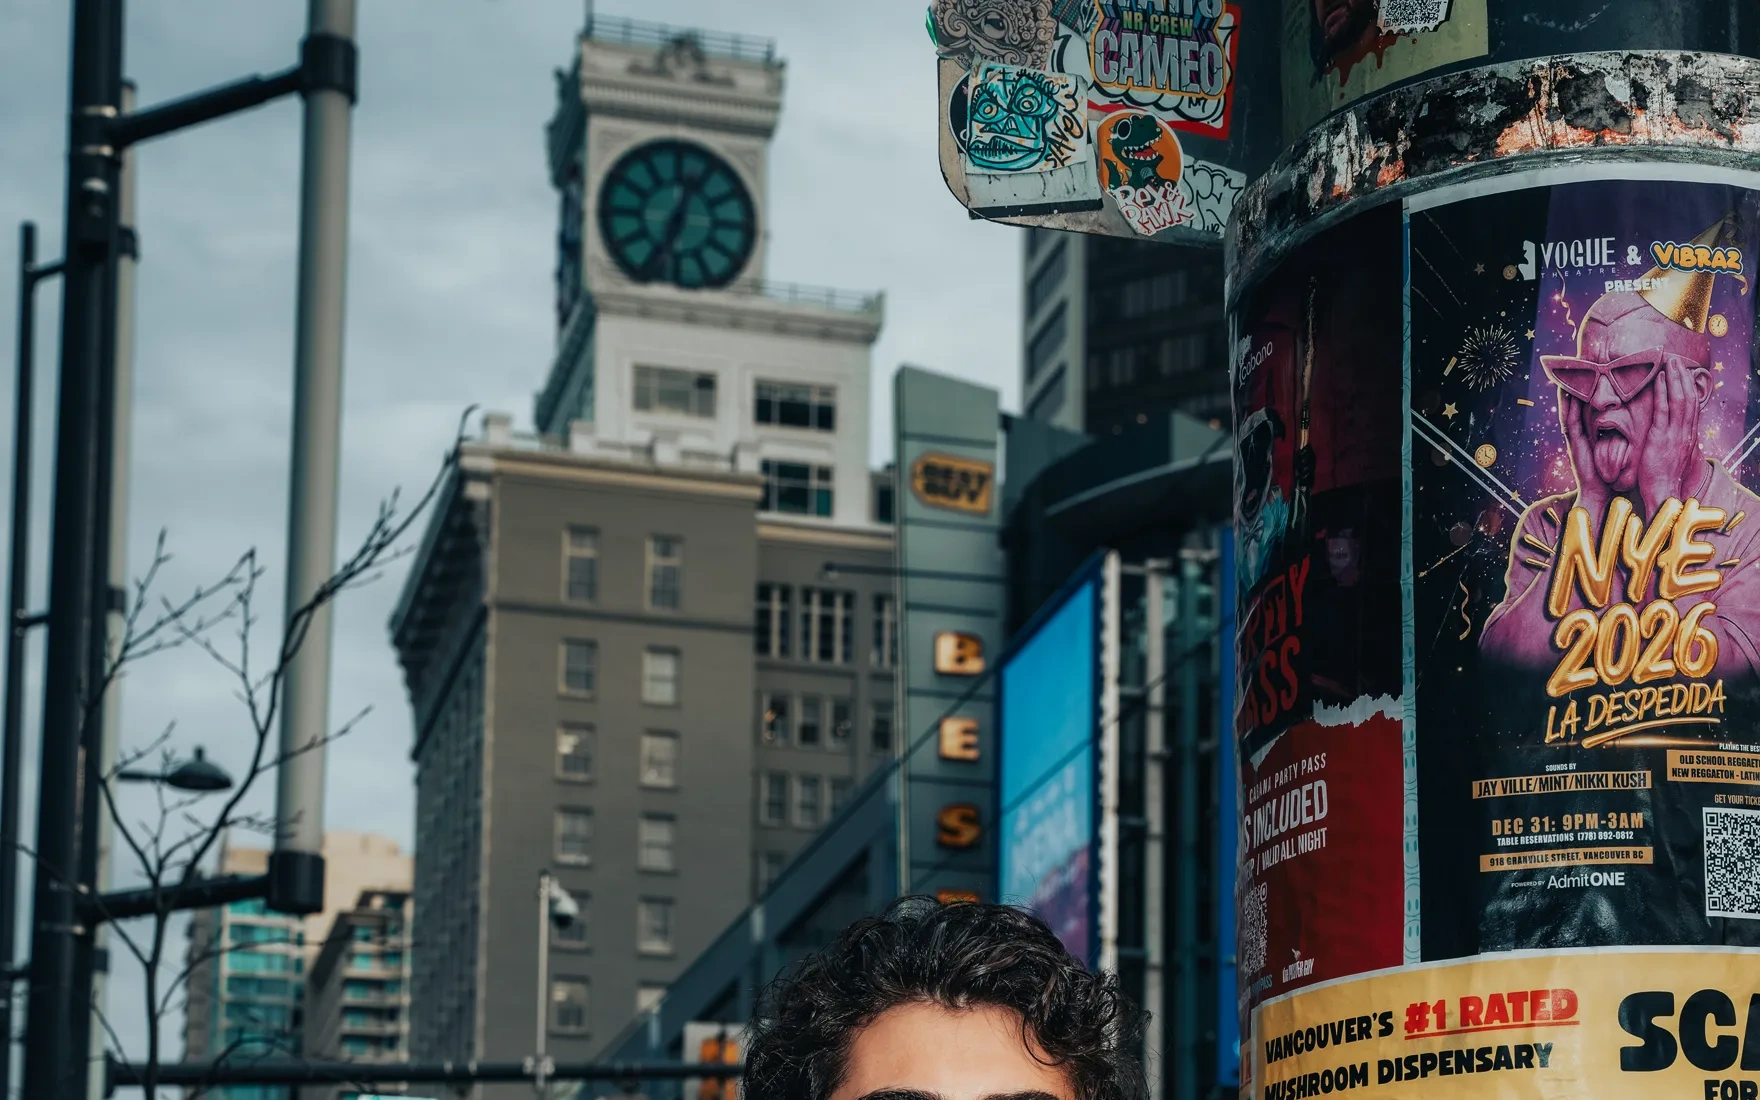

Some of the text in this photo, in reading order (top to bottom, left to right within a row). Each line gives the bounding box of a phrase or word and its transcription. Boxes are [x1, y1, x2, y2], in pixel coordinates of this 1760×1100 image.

[1123, 10, 1193, 37] NR CREW
[1094, 29, 1224, 96] CAMEO
[1541, 237, 1616, 269] VOGUE
[1626, 245, 1641, 266] &
[1541, 267, 1617, 279] THEATRE
[1604, 277, 1670, 293] PRESENT
[1549, 496, 1727, 617] NYE
[1546, 599, 1719, 697] 2026
[1544, 679, 1727, 743] LA DESPEDIDA
[1274, 762, 1299, 786] PARTY
[1301, 752, 1327, 775] PASS
[1546, 764, 1568, 772] SOUNDS
[1680, 755, 1694, 765] OLD
[1696, 756, 1726, 766] SCHOOL
[1477, 781, 1498, 797] JAY
[1613, 773, 1647, 788] KUSH
[1672, 768, 1689, 777] NEW
[1691, 768, 1734, 779] REGGAETON
[1715, 794, 1726, 804] GET
[1728, 795, 1743, 805] YOUR
[1253, 779, 1328, 849] INCLUDED
[1492, 812, 1643, 836] DEC 31: 9PM-3AM
[1262, 847, 1280, 870] VALID
[1280, 841, 1297, 861] ALL
[1298, 827, 1328, 854] NIGHT
[1497, 831, 1634, 847] TABLE RESERVATIONS (778) 892-0812
[1490, 850, 1644, 867] 918 GRANVILLE STREET, VANCOUVER BC
[1547, 872, 1625, 889] AdmitONE
[1265, 988, 1578, 1064] VANCOUVER'S #1 RATED
[1377, 1042, 1553, 1085] DISPENSARY
